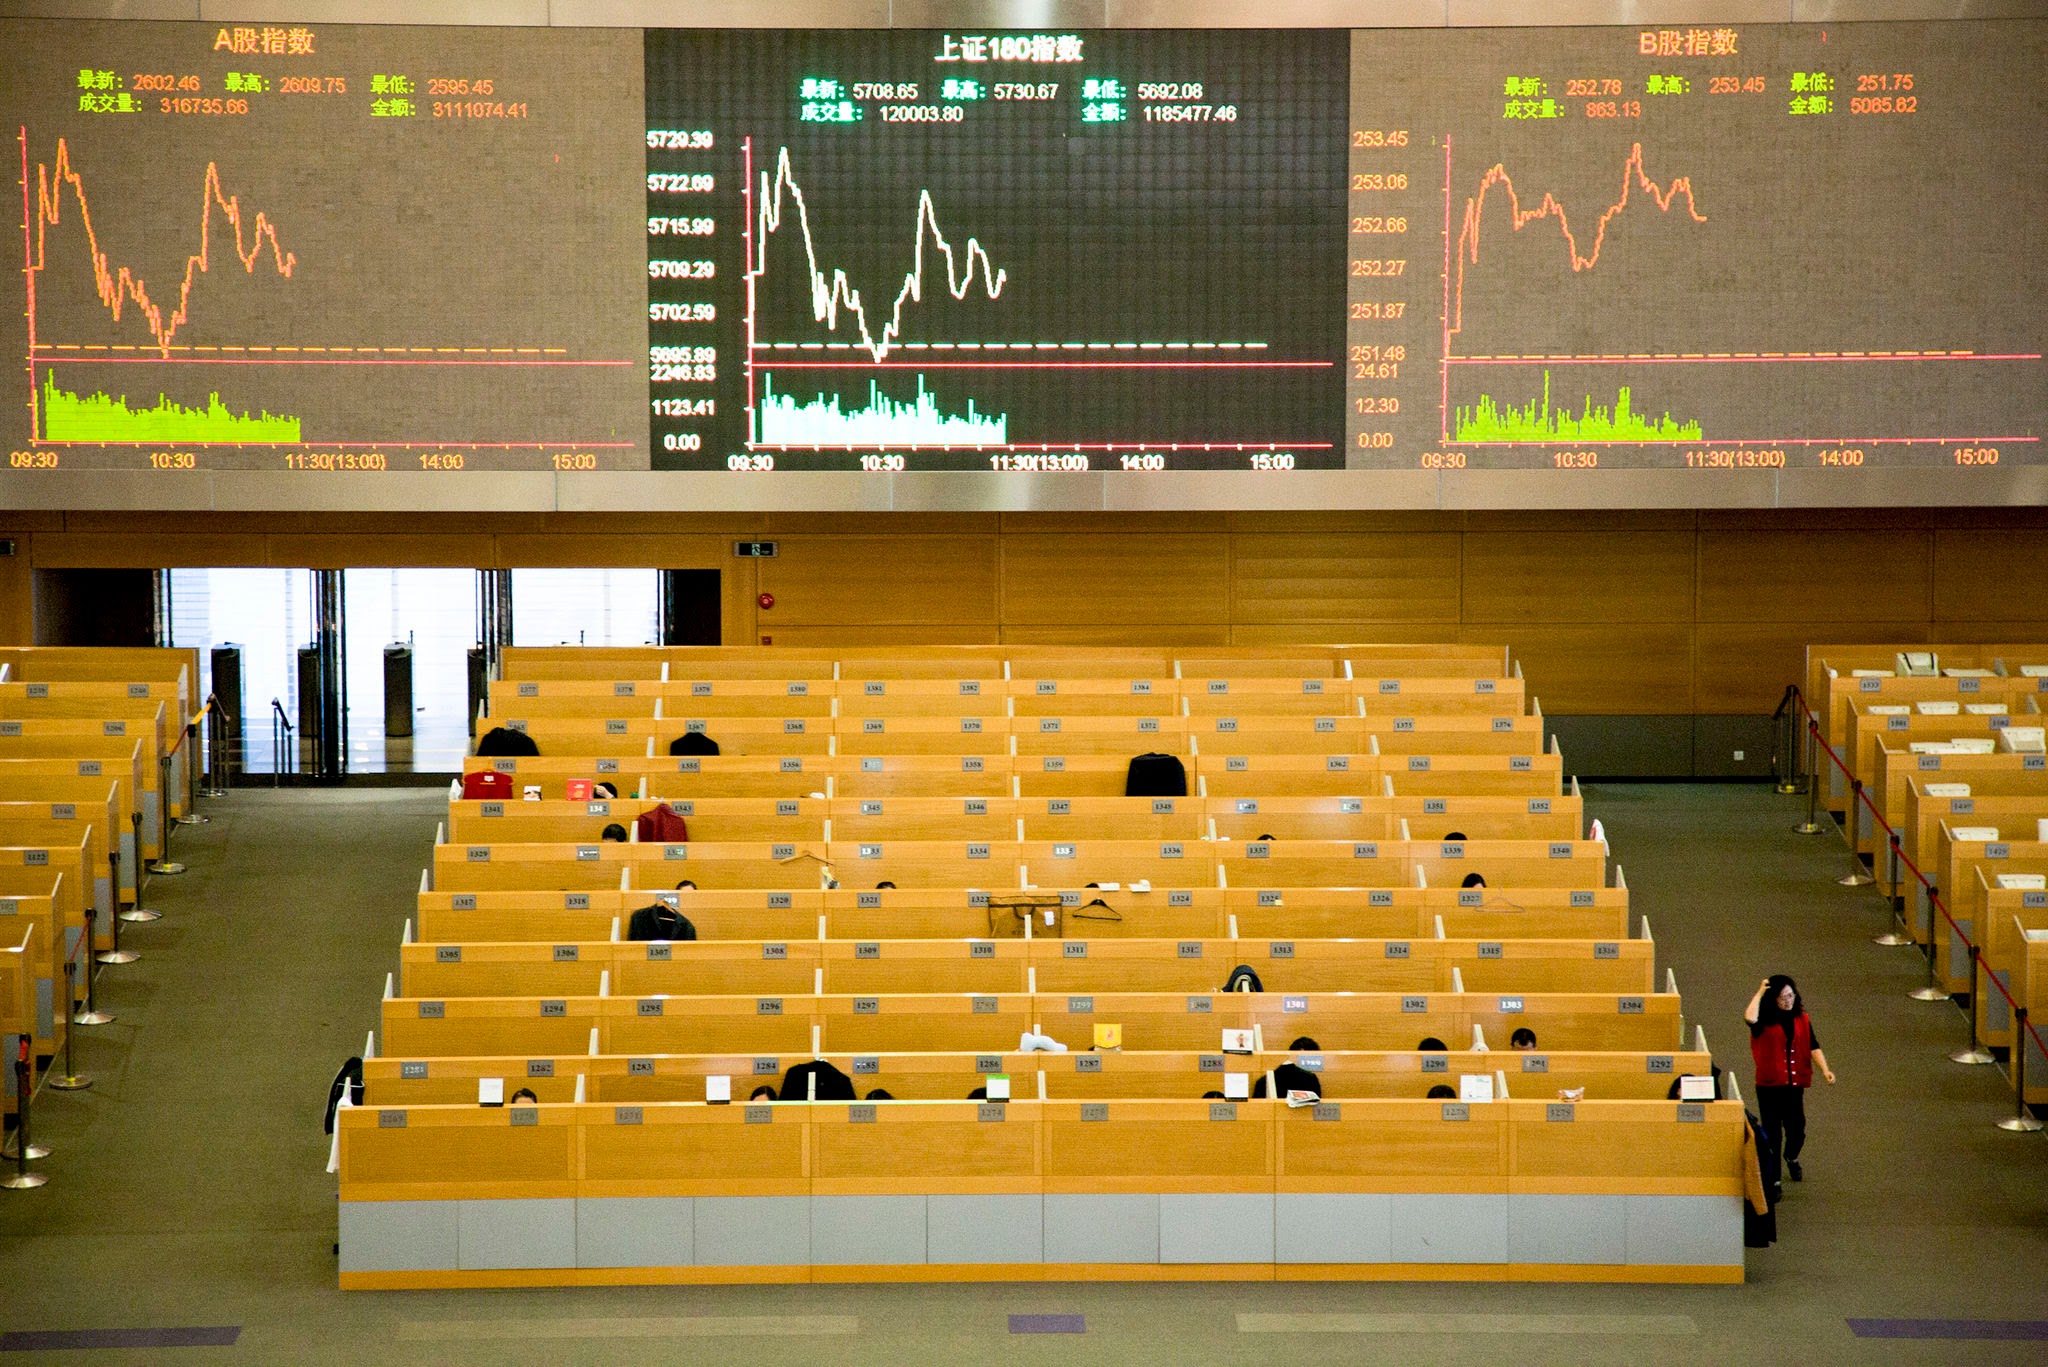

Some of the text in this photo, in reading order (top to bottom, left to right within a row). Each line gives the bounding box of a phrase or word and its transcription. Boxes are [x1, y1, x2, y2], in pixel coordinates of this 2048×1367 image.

[214, 27, 314, 54] A股指数
[1639, 29, 1738, 55] B股指数
[934, 35, 1083, 62] 上证180指数
[133, 74, 200, 91] 2602.46
[280, 77, 346, 94] 2609.75
[429, 79, 493, 95] 2595.45
[1567, 79, 1622, 96] 252.78
[1710, 76, 1765, 94] 253.45
[1857, 74, 1914, 92] 251.75
[853, 83, 919, 100] 5708.65
[994, 83, 1059, 100] 5730.67
[1138, 83, 1203, 100] 5692.08
[434, 102, 526, 118] 3111074.41
[880, 105, 964, 122] 120003.80
[1144, 105, 1237, 122] 1185477.46
[1353, 131, 1408, 147] 253.45
[1352, 174, 1408, 190] 253.06
[1352, 217, 1407, 233] 252.66
[649, 260, 715, 278] 5709.29
[1351, 260, 1406, 276] 252.27
[649, 303, 716, 321] 5702.59
[1350, 303, 1405, 319] 251.87
[1350, 346, 1405, 361] 251.48
[1355, 363, 1399, 379] 24.61
[651, 398, 715, 417] 1123.41
[1356, 398, 1399, 413] 12.30
[664, 433, 701, 450] 0.00
[1358, 433, 1393, 449] 0.00
[10, 451, 596, 471] 09:30 10:30 11:30(13:00) 14:00 15:00
[727, 454, 1295, 471] 09:30 10:30 11:30(13:00) 14:00 15:00
[1422, 448, 1999, 468] 09:30 10:30 11:30(13:00) 14:00 15:00
[470, 850, 488, 858] 1329
[970, 847, 988, 855] 1334
[455, 898, 473, 906] 1317
[860, 896, 878, 904] 1321
[556, 949, 576, 957] 1306
[650, 948, 669, 956] 1307
[766, 947, 785, 955] 1308
[974, 946, 993, 954] 1310
[1066, 946, 1084, 954] 1311
[1273, 946, 1292, 954] 1313
[1389, 946, 1407, 954] 1314
[1481, 947, 1500, 955] 1315
[544, 1005, 564, 1013] 1294
[641, 1004, 661, 1012] 1295
[761, 1002, 780, 1010] 1296
[857, 1002, 876, 1010] 1297
[1286, 1000, 1306, 1009] 1301
[1405, 1000, 1425, 1009] 1302
[1501, 1000, 1522, 1009] 1303
[632, 1063, 652, 1071] 1283
[756, 1062, 776, 1070] 1284
[979, 1060, 1000, 1068] 1286
[1079, 1059, 1099, 1067] 1287
[1202, 1060, 1223, 1068] 1288
[1425, 1060, 1446, 1068] 1290
[1651, 1060, 1671, 1069] 1292
[531, 1064, 551, 1072] 1282
